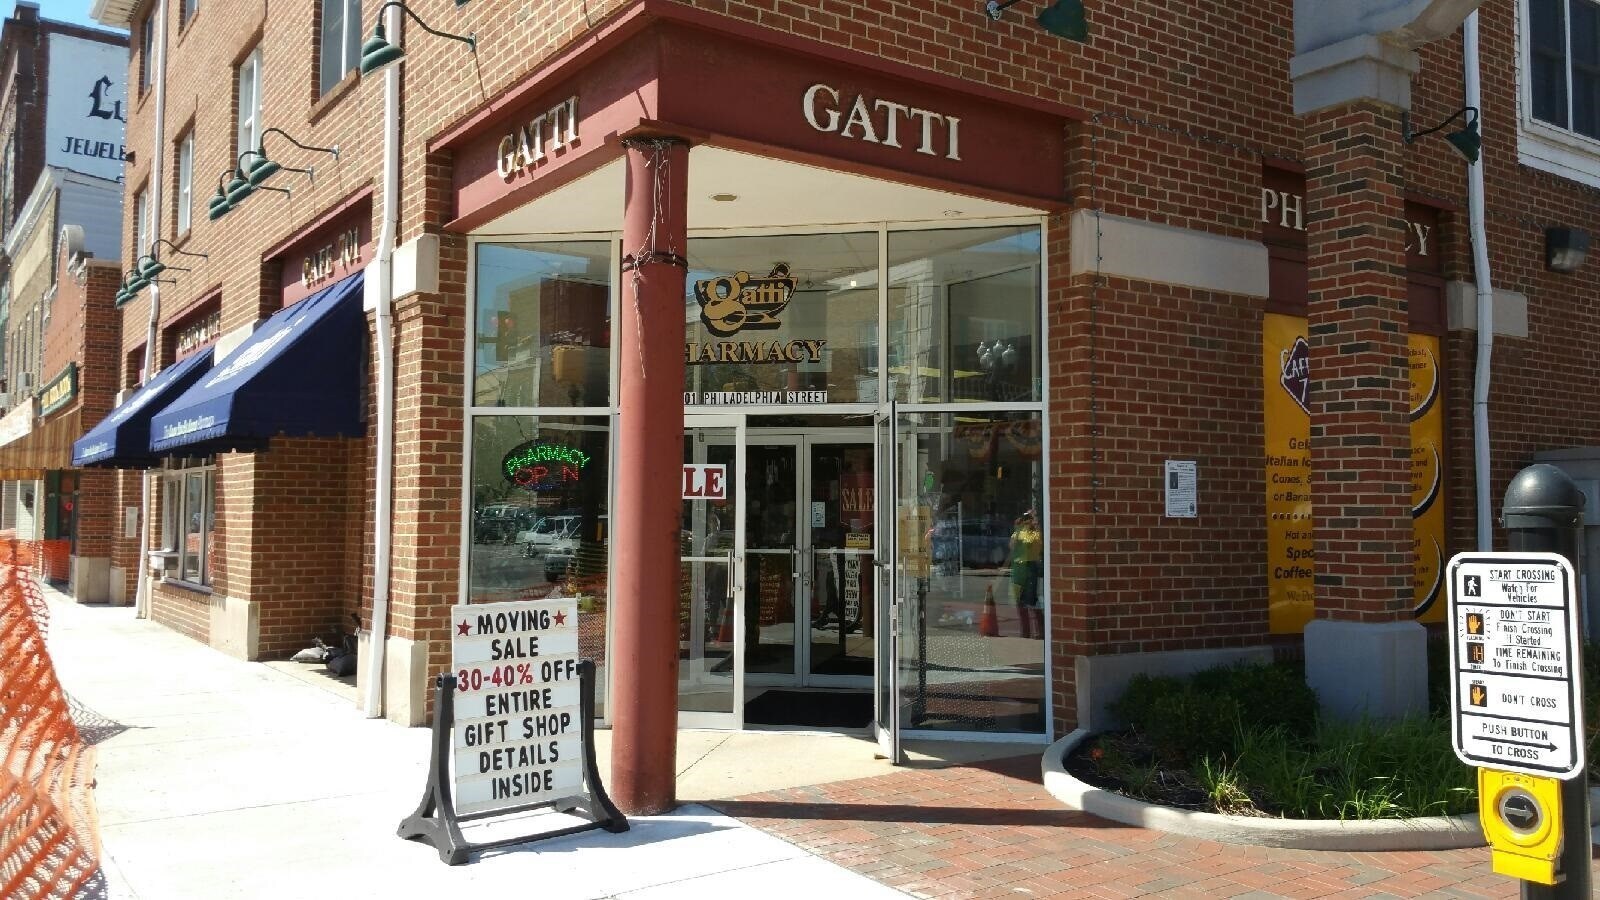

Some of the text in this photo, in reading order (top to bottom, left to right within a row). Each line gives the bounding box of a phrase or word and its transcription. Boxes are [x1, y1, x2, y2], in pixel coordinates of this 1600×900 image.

[803, 84, 961, 160] GATTI
[498, 96, 579, 178] GATTI
[61, 136, 126, 161] JEWELE
[701, 270, 786, 336] gatti
[686, 340, 827, 364] HARMACY
[684, 391, 827, 405] 01 PHILADELPHIA STREET
[506, 445, 590, 476] PHARMACY
[1265, 455, 1298, 467] Italian
[515, 466, 578, 485] OPN
[684, 468, 723, 497] LE
[842, 488, 874, 511] SALE
[1302, 531, 1313, 540] an
[1286, 546, 1314, 561] Spec
[1489, 569, 1555, 581] START CROSSING
[1507, 592, 1538, 603] Vehicles
[477, 609, 551, 635] MOVING
[1500, 609, 1550, 621] DON'T START
[1496, 623, 1553, 637] Fnish Crossing
[1514, 634, 1541, 645] Started
[491, 636, 539, 660] SALE
[1495, 647, 1561, 661] TIME REMAINING
[458, 659, 575, 692] 30-40% OFF
[1493, 658, 1563, 676] To Finish Crossing
[486, 688, 552, 716] ENTIRE
[1502, 693, 1557, 709] DON'T CROSS
[465, 713, 571, 746] GIFT SHOP
[1482, 723, 1548, 740] PUSH BUTTON
[479, 741, 559, 774] DETAILS
[1491, 744, 1539, 760] TO CROSS
[492, 769, 553, 800] INSIDE
